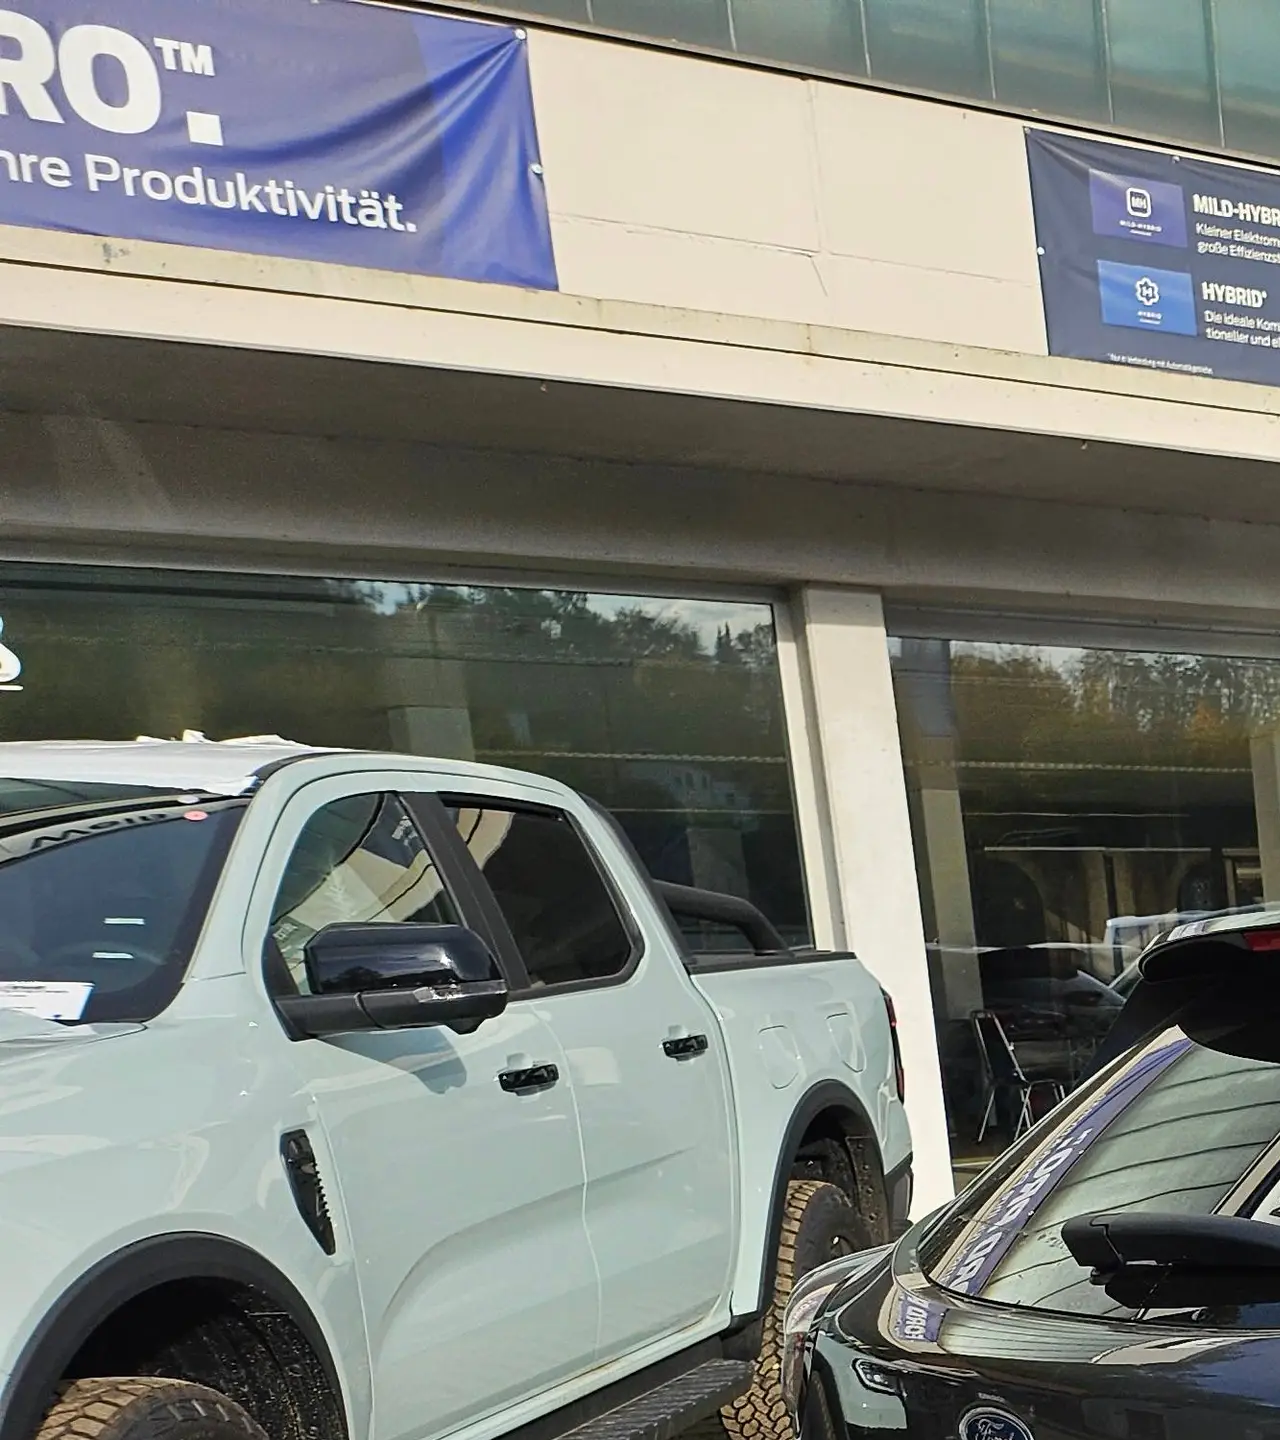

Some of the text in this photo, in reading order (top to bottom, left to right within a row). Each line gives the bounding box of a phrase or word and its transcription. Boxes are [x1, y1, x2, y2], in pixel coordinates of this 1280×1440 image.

[86, 154, 417, 233] Produktivität.
[1195, 222, 1233, 241] Kleiner
[1197, 241, 1229, 257] große
[1203, 310, 1223, 325] Die
[1223, 312, 1256, 329] ideale
[1250, 332, 1272, 348] und
